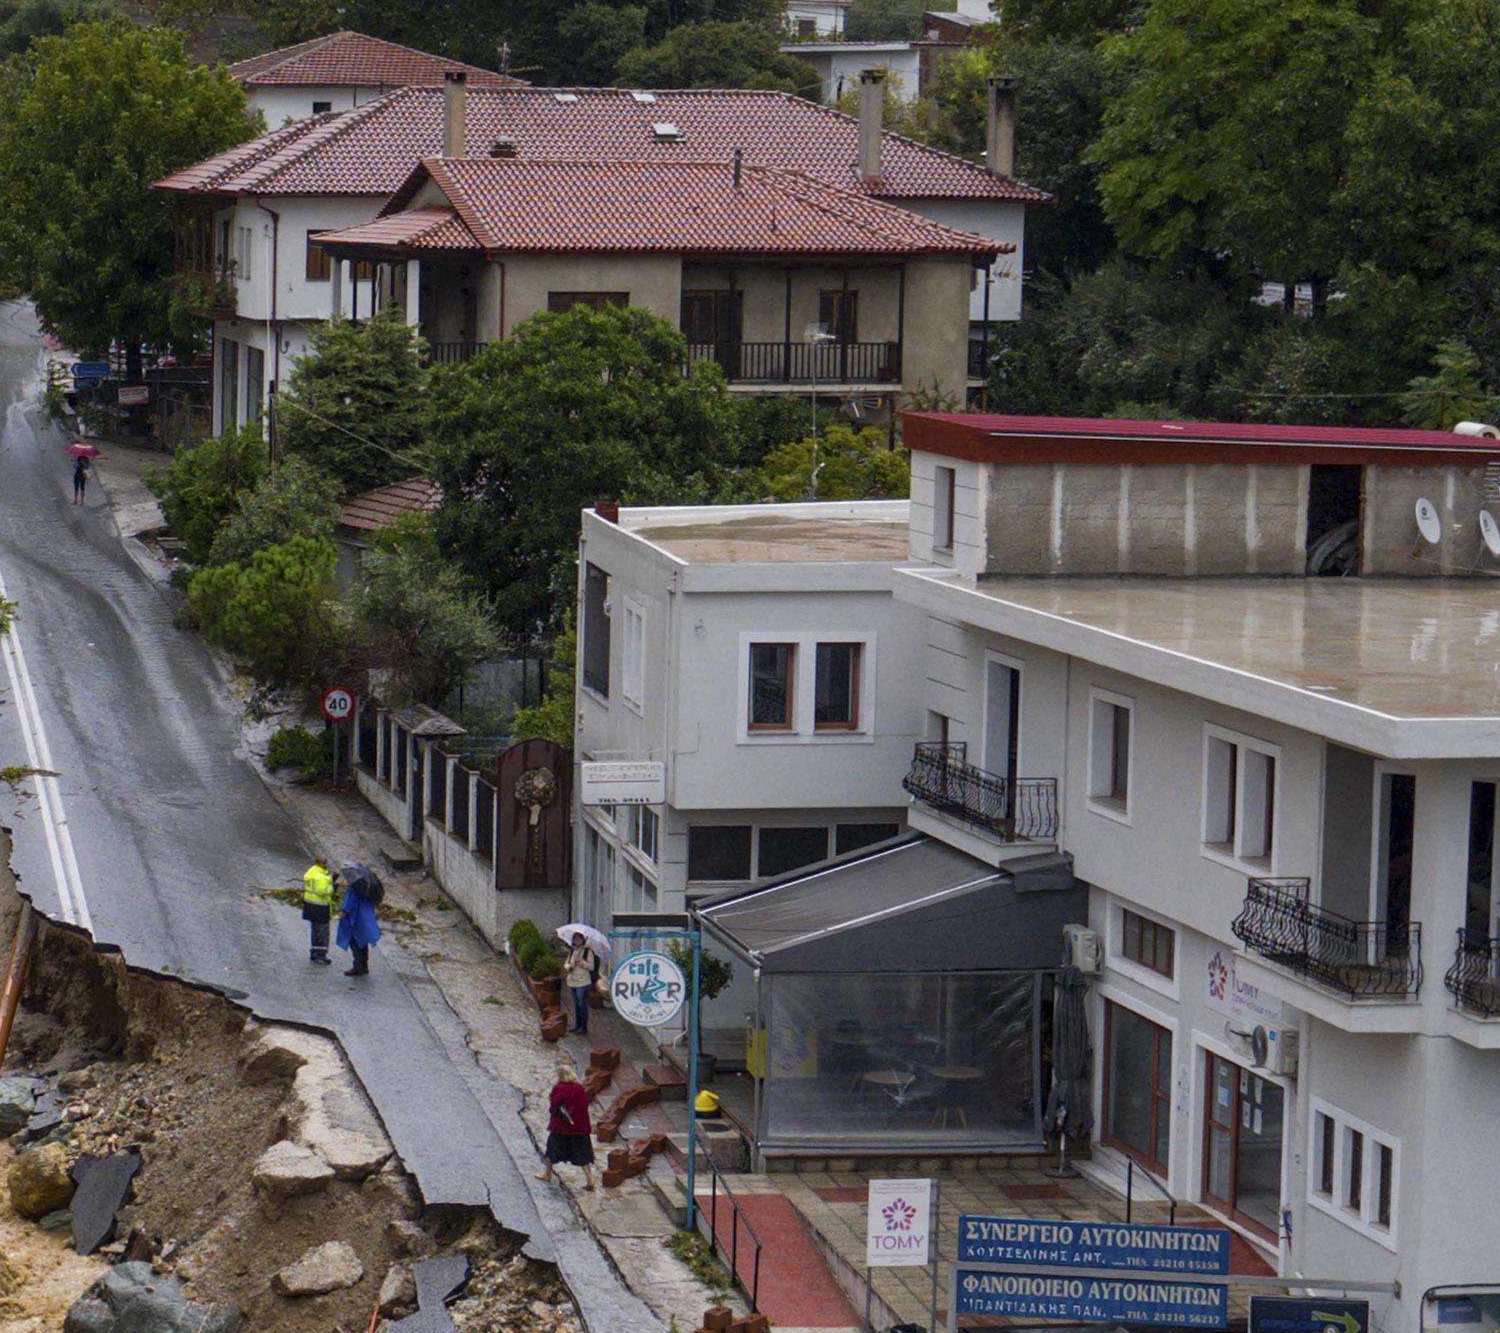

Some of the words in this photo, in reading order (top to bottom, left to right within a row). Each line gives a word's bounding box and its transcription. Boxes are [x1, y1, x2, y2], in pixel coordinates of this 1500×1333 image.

[329, 698, 347, 710] 40
[628, 959, 659, 976] cafe
[966, 1222, 1074, 1246] ΣΥΝΕΡΓΕΙΟ
[1079, 1229, 1220, 1252] ΑΥΤΟΚΙΝΗΤΩΝ
[1073, 1252, 1106, 1265] ΑΝΤ.
[963, 1277, 1083, 1299] ΦΑΝΟΠΟΙΕΙΟ
[1088, 1281, 1220, 1306] ΑΥΤΟΚΙΝΗΤΩΝ
[1073, 1305, 1106, 1318] ΠΑΝ.
